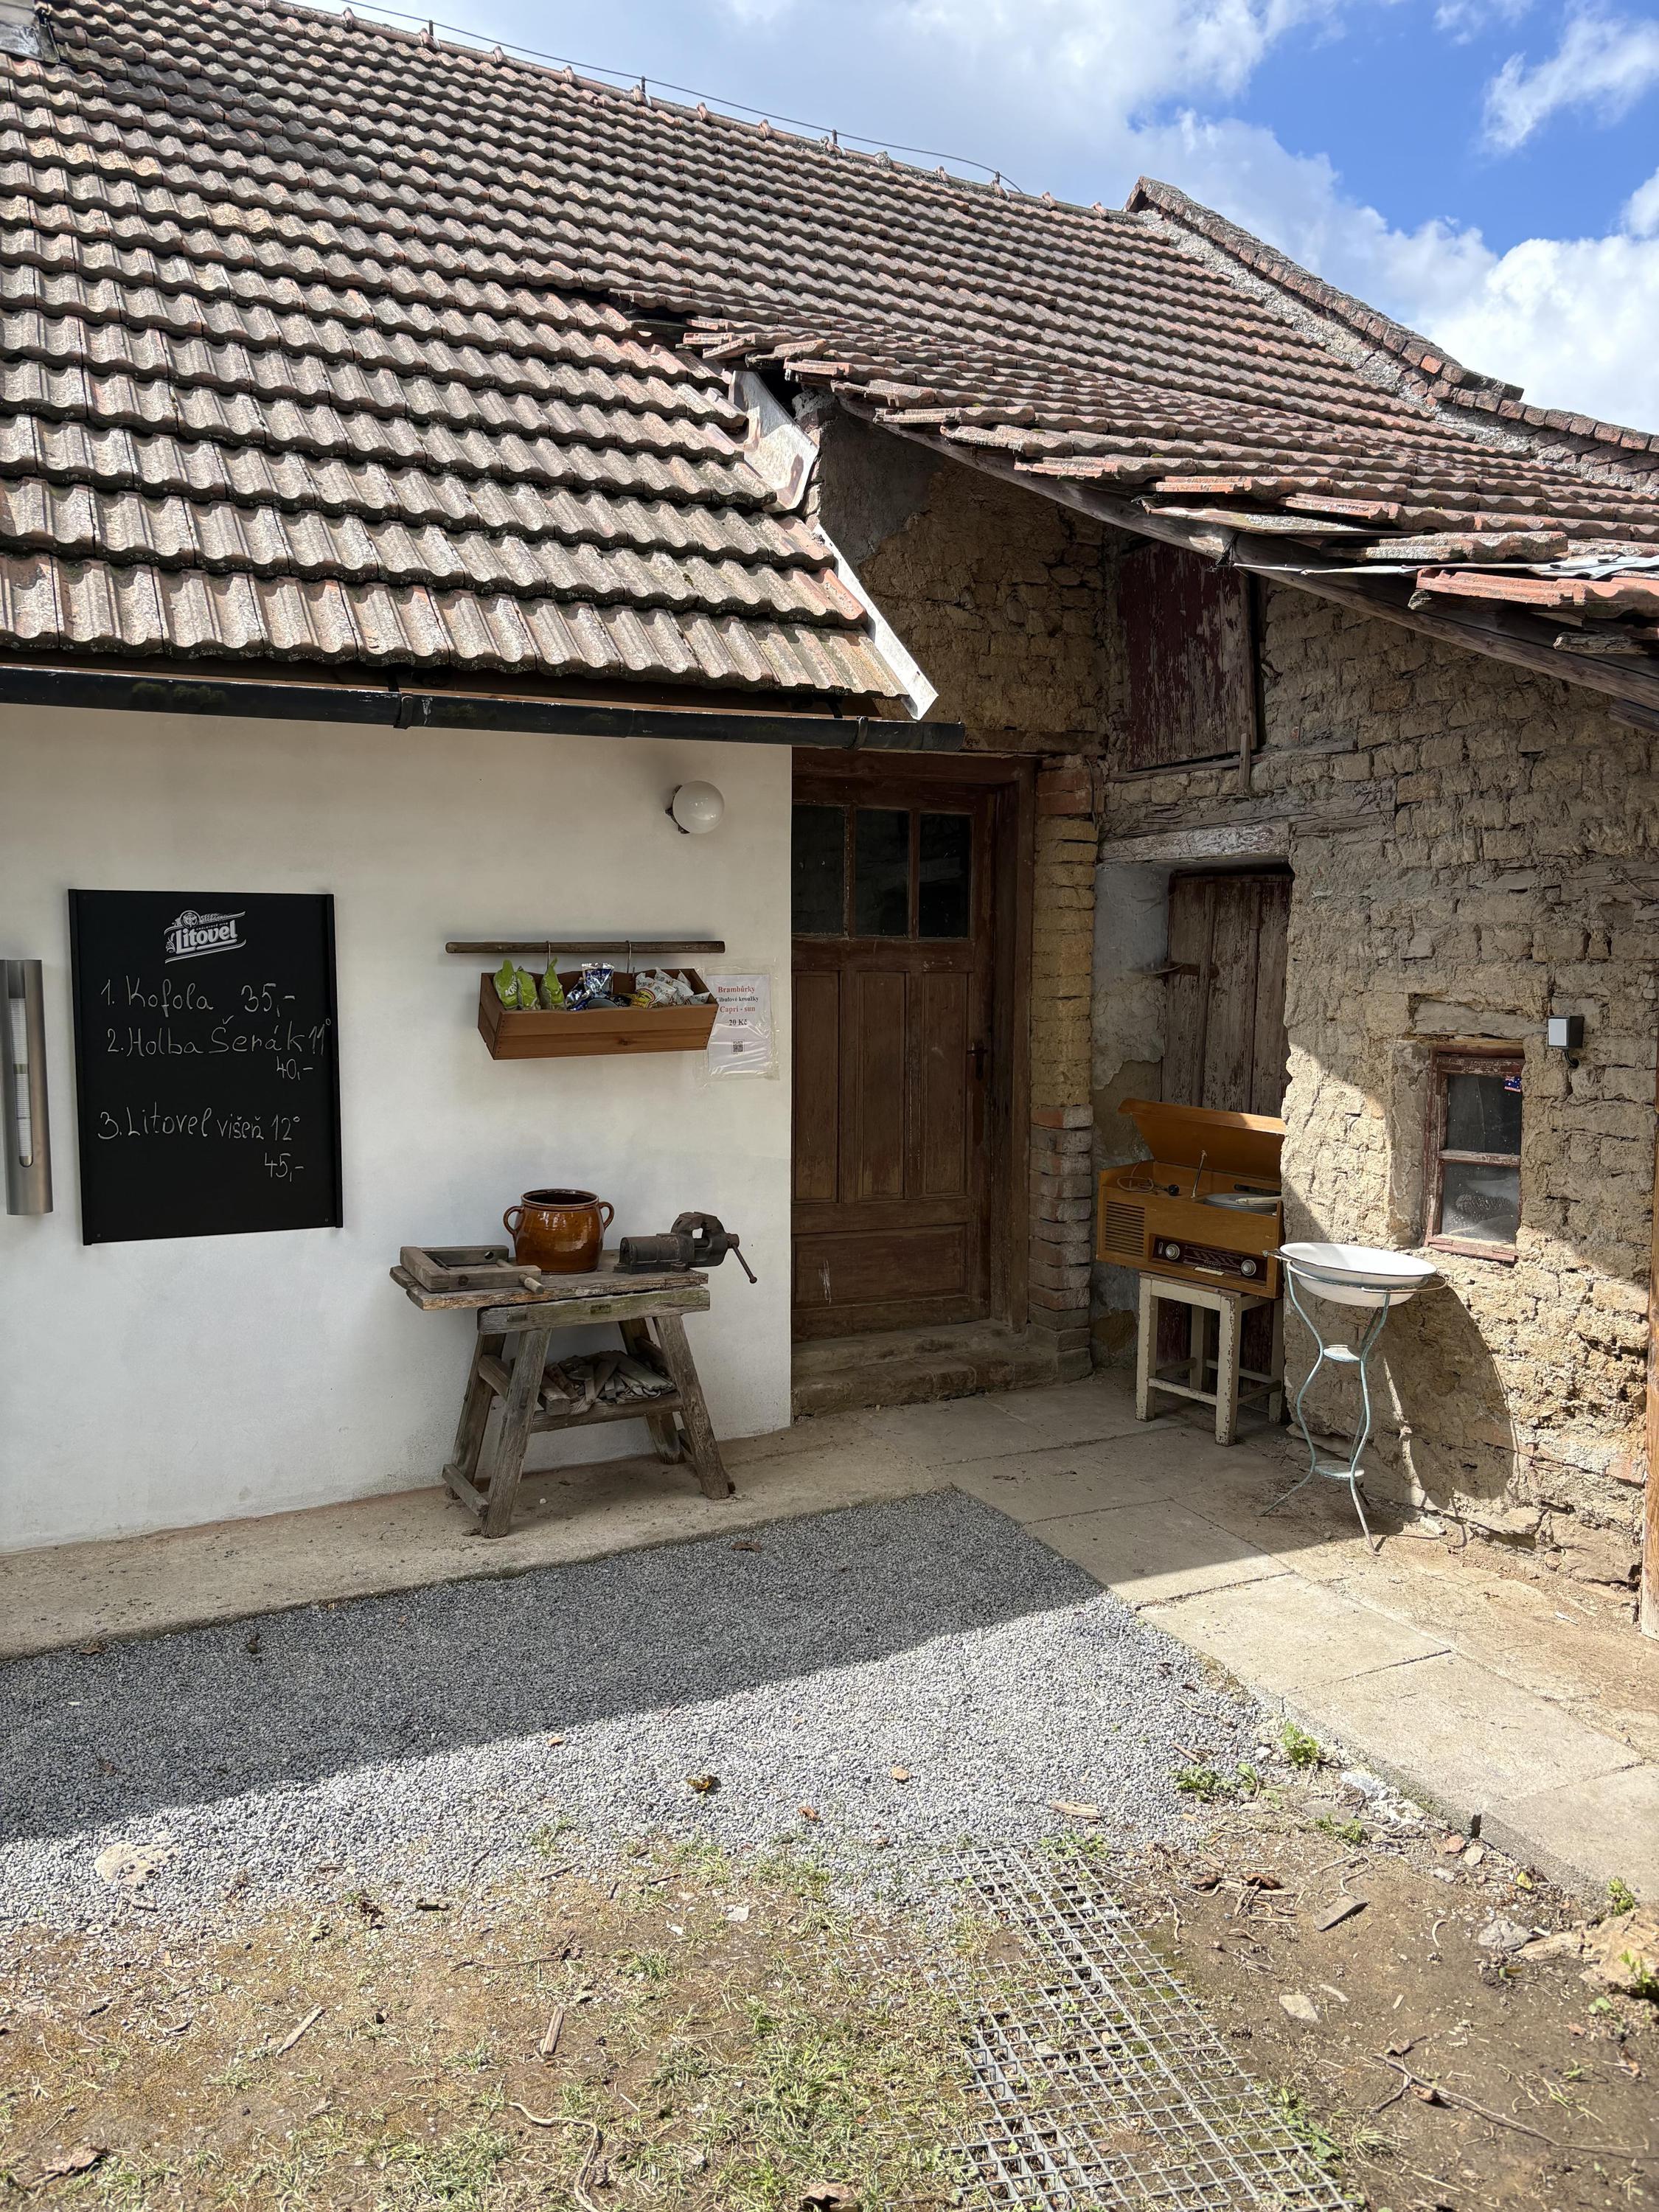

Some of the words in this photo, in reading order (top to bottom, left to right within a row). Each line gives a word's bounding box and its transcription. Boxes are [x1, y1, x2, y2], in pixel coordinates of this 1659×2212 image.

[175, 919, 238, 954] Litovel
[100, 978, 115, 1006] 1.
[125, 975, 214, 1018] Kofola
[717, 985, 756, 994] Brambůrky
[720, 1005, 739, 1015] Capri
[276, 1055, 313, 1080] 40,-
[264, 1152, 305, 1183] 45,-
